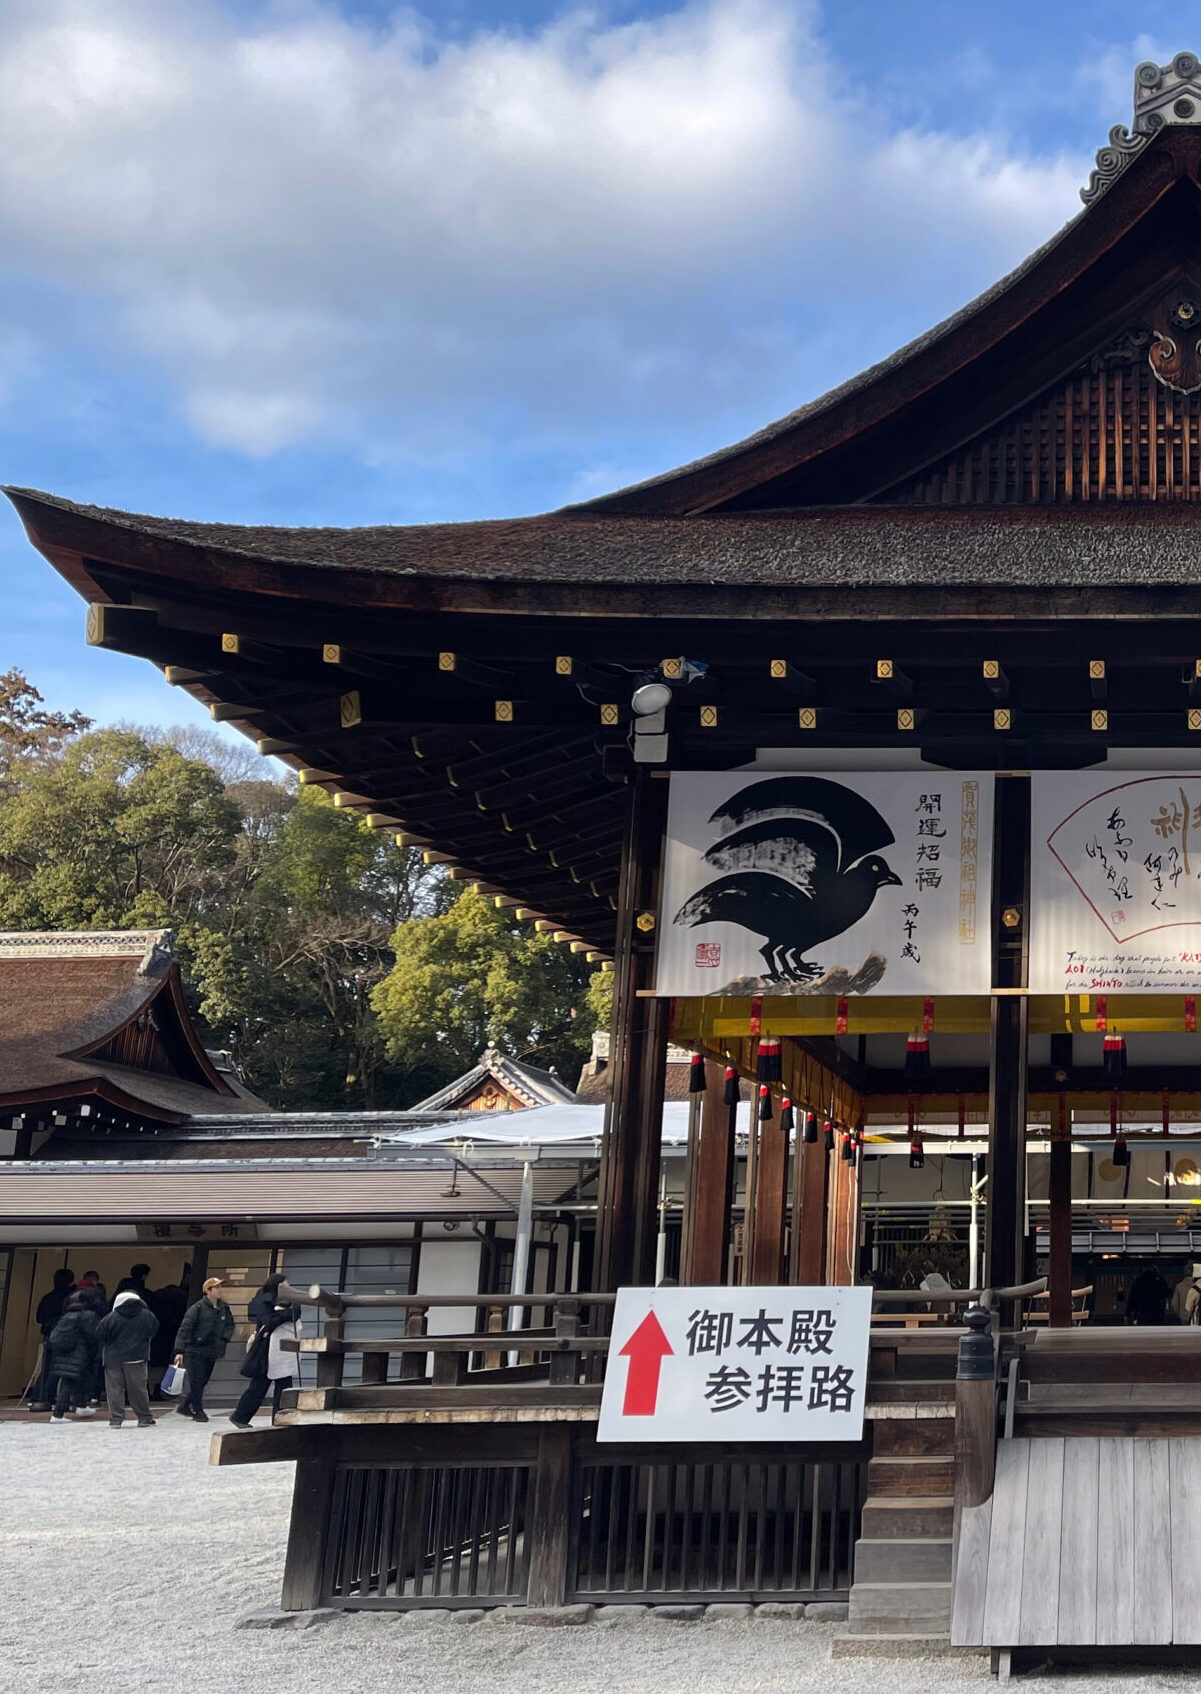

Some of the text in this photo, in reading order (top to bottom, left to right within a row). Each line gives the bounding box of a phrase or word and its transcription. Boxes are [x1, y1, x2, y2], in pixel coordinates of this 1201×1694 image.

[915, 794, 946, 891] 開運招福
[685, 1308, 837, 1356] 御本殿
[704, 1364, 856, 1413] 参拝路
